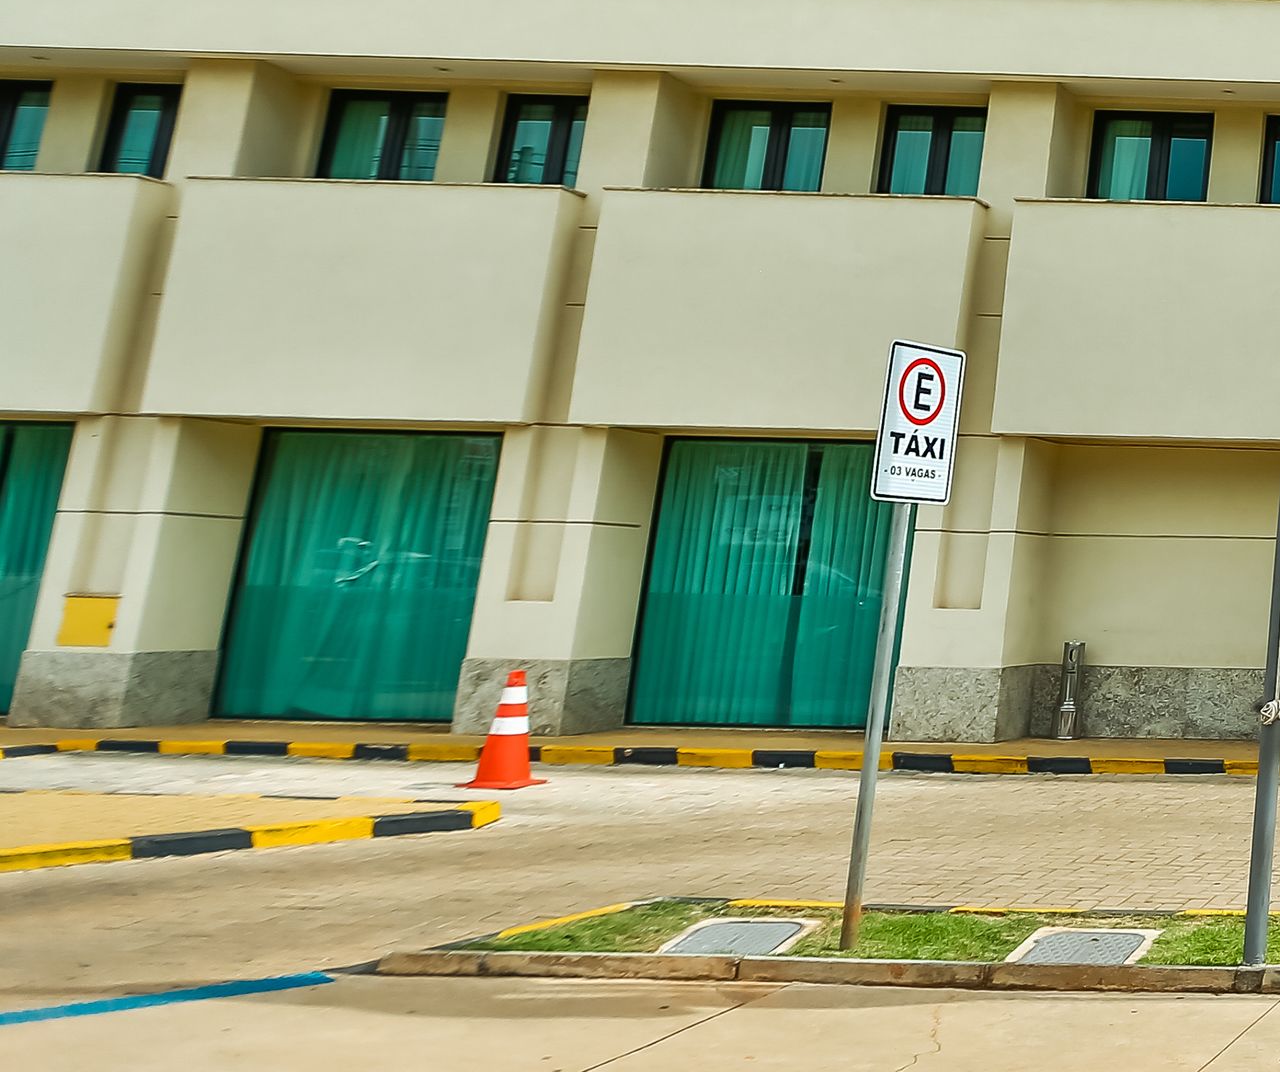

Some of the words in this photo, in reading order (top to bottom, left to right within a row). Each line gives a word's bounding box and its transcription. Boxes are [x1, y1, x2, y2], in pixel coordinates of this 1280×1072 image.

[914, 372, 934, 411] E
[890, 429, 945, 460] TÁXI
[890, 466, 902, 475] 03
[905, 467, 936, 479] VAGAS
